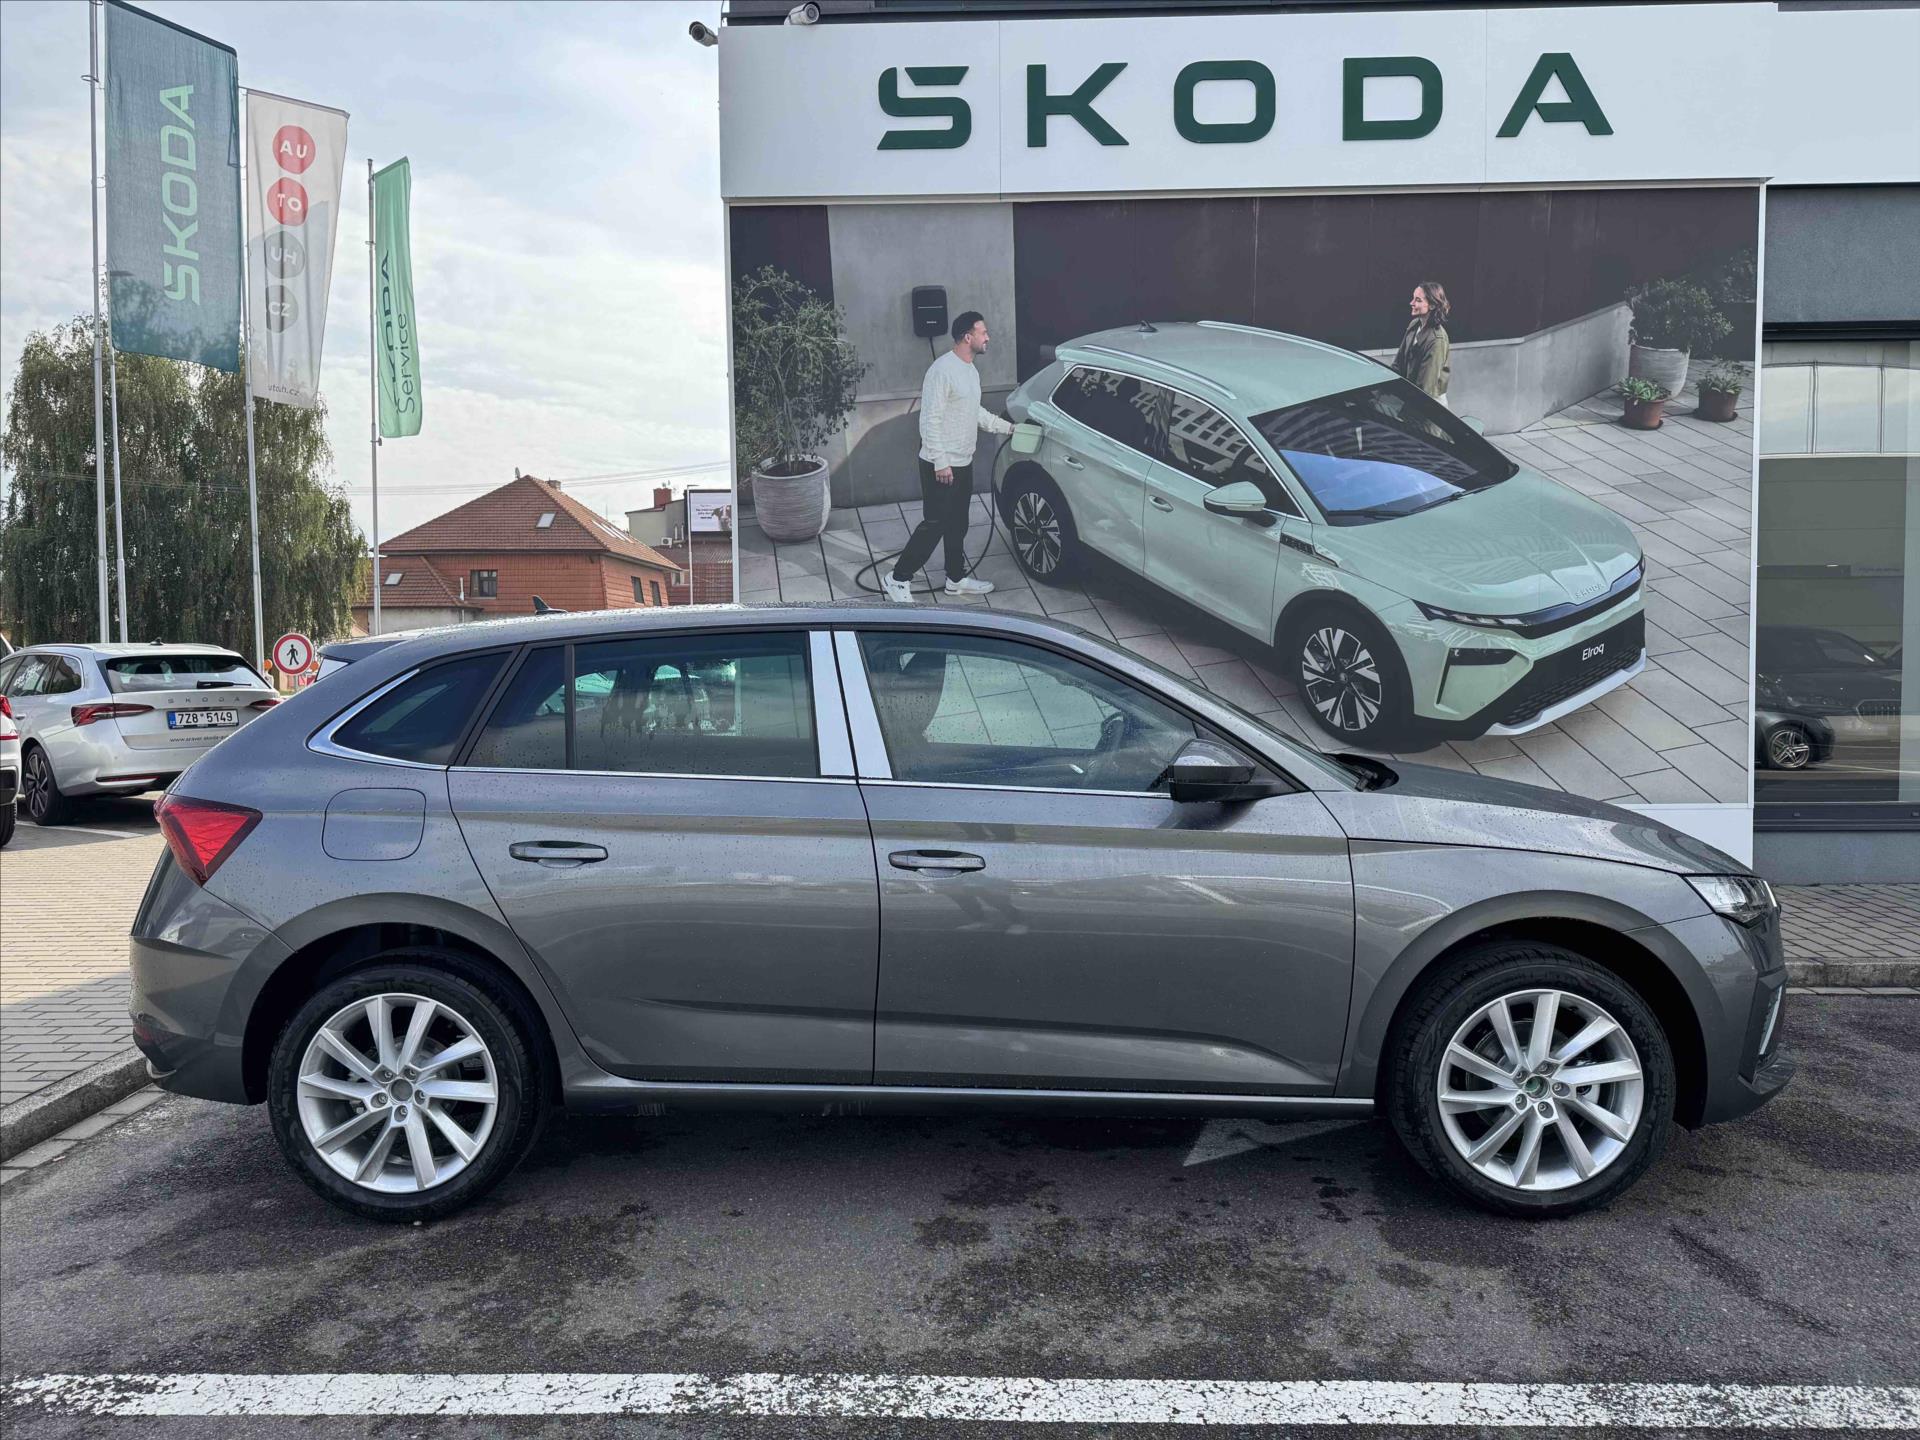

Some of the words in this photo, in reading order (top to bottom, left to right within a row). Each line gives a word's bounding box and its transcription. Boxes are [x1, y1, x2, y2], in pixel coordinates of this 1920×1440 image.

[270, 246, 297, 266] UH
[268, 300, 291, 317] CZ
[394, 312, 416, 414] Service
[1582, 643, 1605, 661] Elroq
[178, 713, 199, 724] 7Z8
[206, 712, 233, 722] 5149
